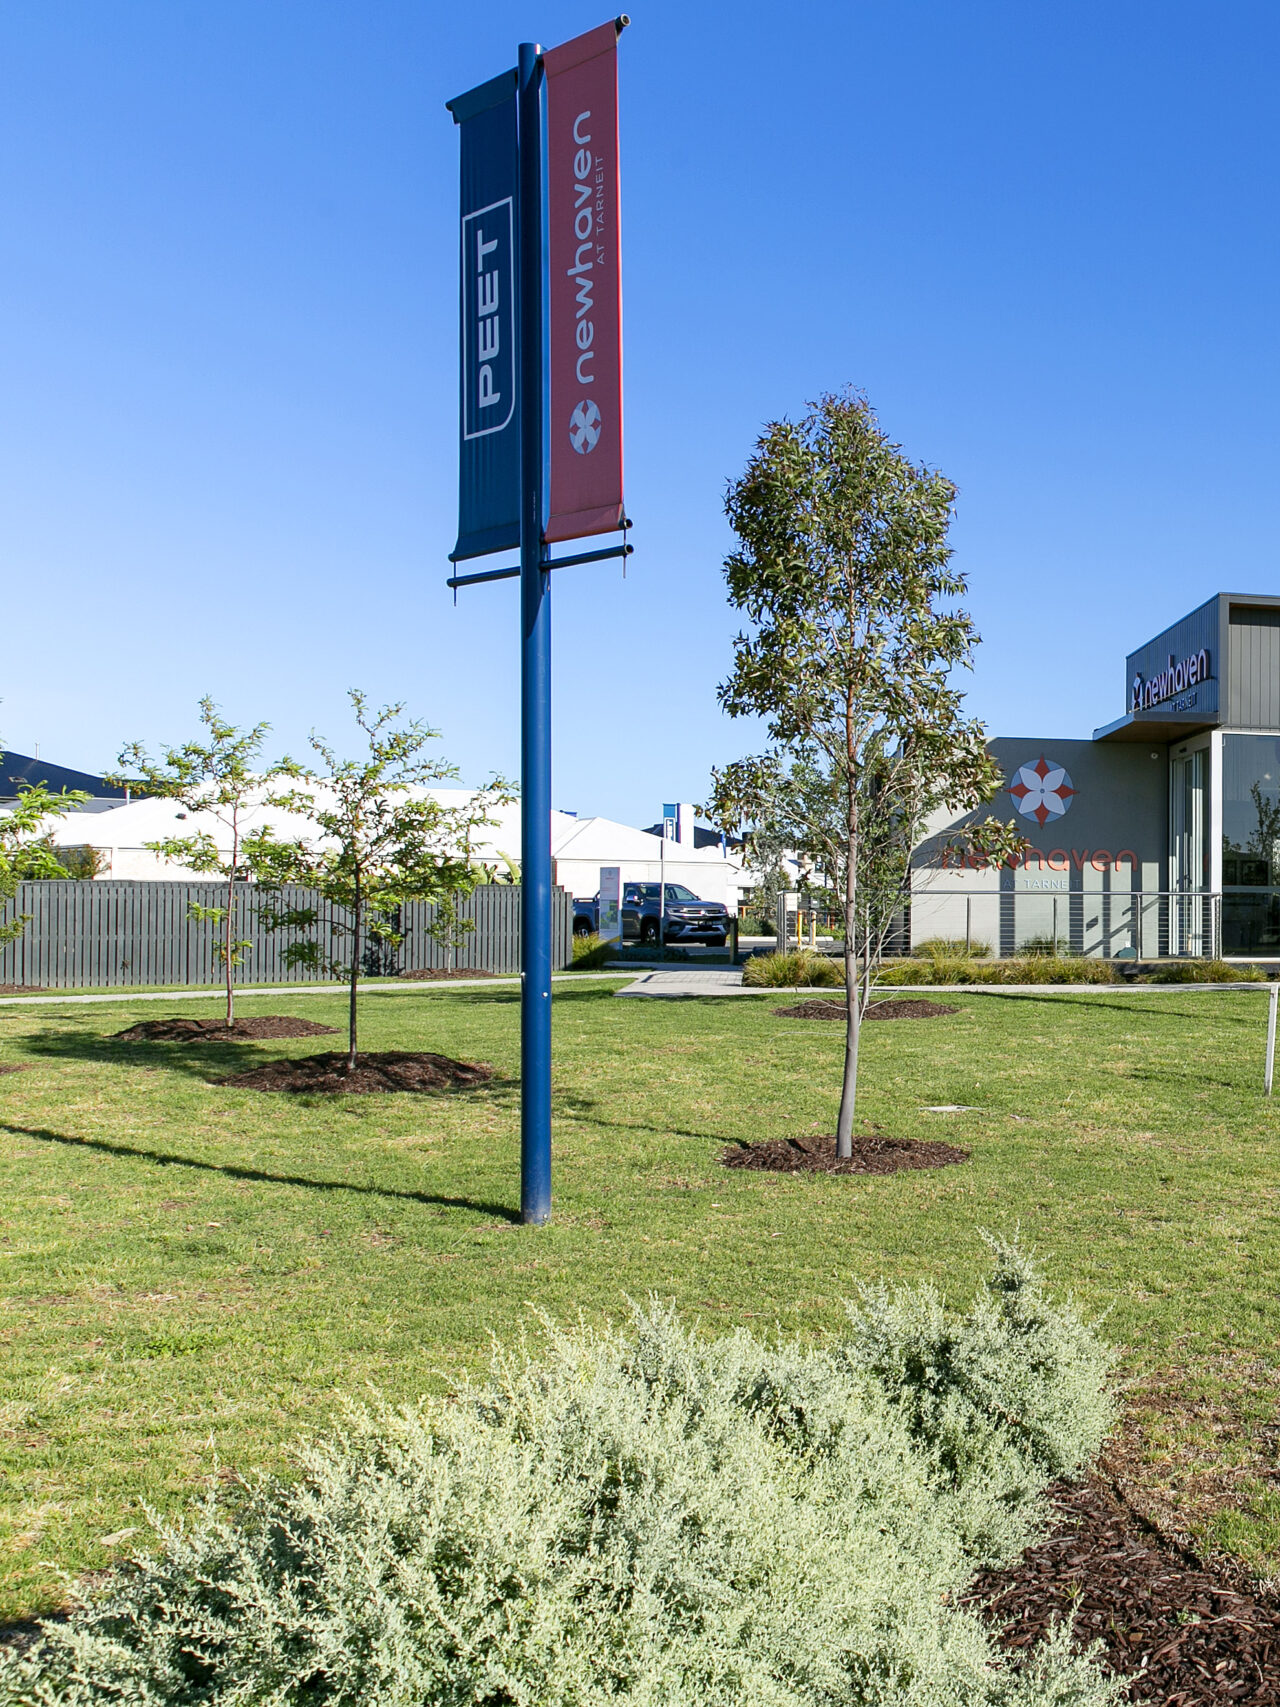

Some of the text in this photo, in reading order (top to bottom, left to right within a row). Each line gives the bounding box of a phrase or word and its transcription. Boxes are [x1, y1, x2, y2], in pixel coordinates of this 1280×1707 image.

[567, 110, 595, 385] newhaven
[595, 156, 606, 265] AT TARNEIT
[477, 228, 501, 409] PEET
[1144, 649, 1207, 709] newhaven
[1002, 879, 1019, 889] AT
